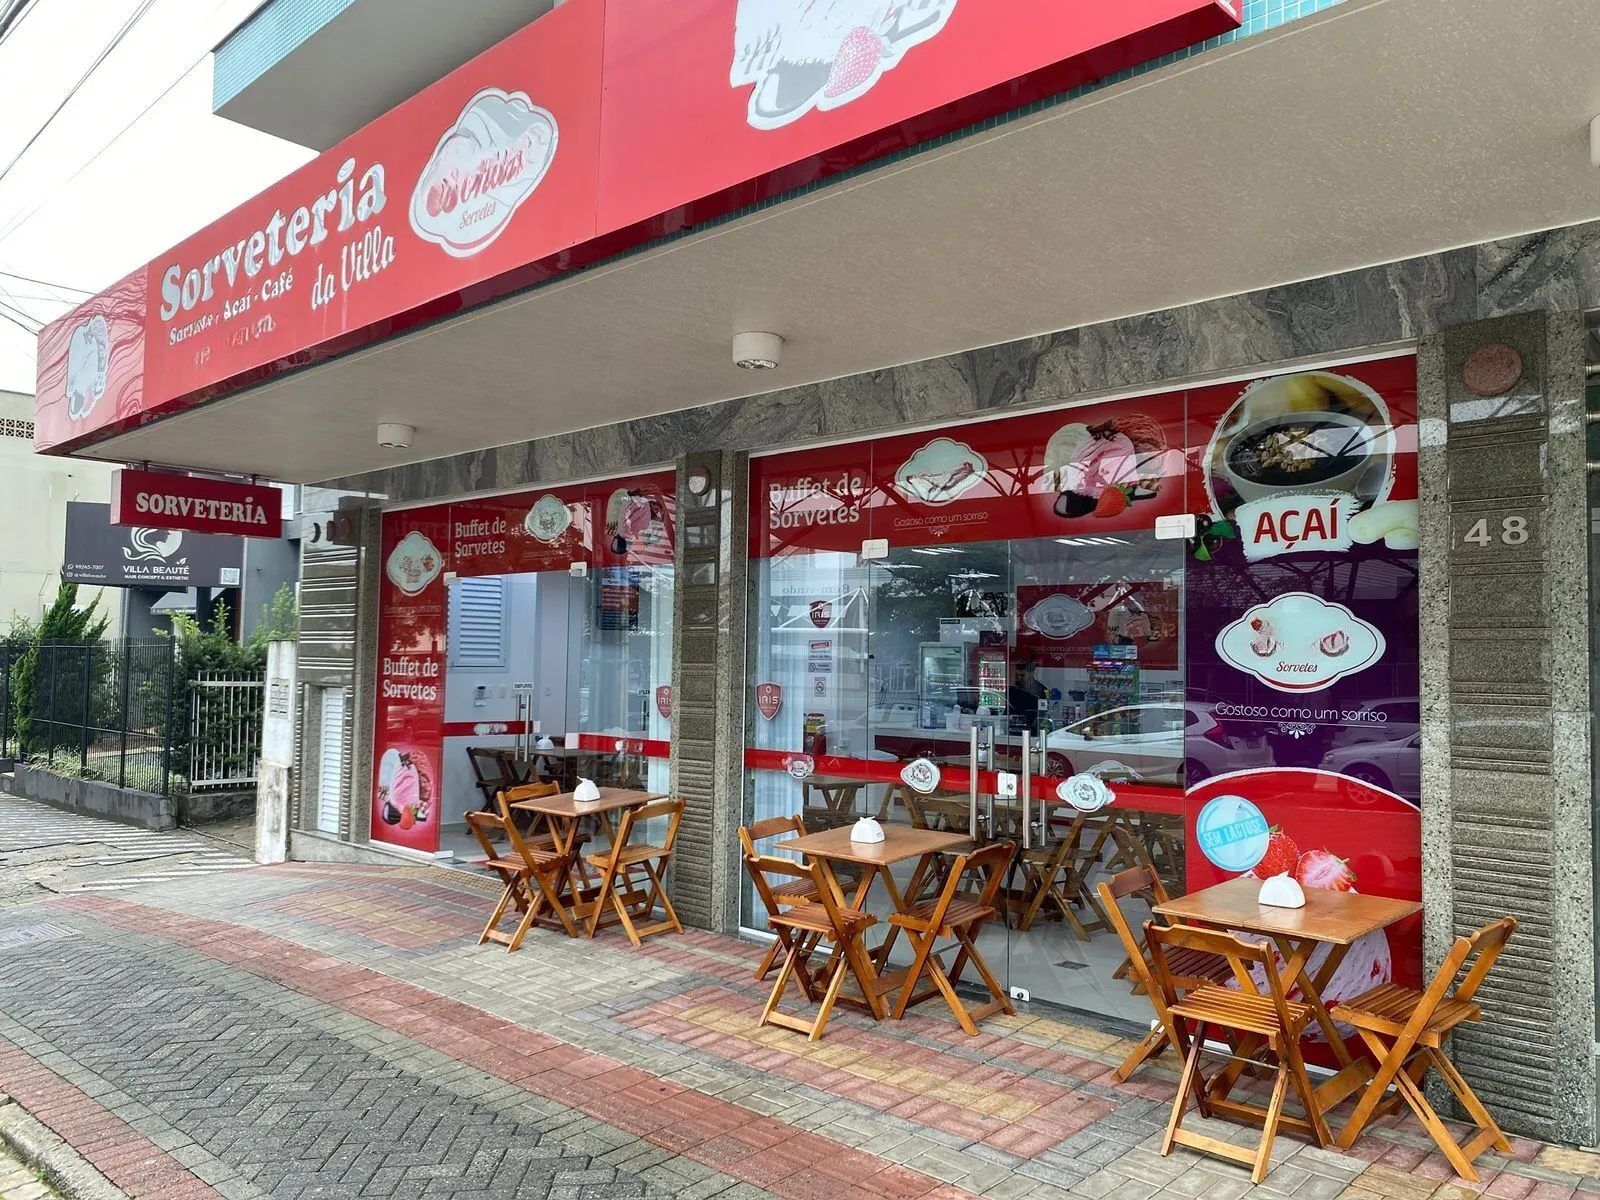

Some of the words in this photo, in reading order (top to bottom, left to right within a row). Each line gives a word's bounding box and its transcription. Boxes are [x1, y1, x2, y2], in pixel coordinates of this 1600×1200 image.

[459, 201, 497, 230] Sorvetes
[160, 157, 388, 322] Sorveteria
[311, 263, 336, 311] da
[341, 225, 396, 292] Villa
[262, 267, 294, 301] Café
[769, 475, 831, 504] Buffet
[836, 472, 862, 497] de
[454, 518, 489, 538] Buffet
[491, 516, 506, 535] de
[769, 505, 860, 530] Sorvetes
[893, 517, 924, 527] Gostoso
[924, 515, 948, 525] como
[948, 514, 962, 523] um
[963, 511, 989, 521] sorriso
[1253, 498, 1341, 550] AÇAÍ
[1463, 515, 1529, 547] 48
[454, 539, 505, 558] Sorvetes
[122, 565, 149, 574] VILLA
[152, 565, 190, 575] BEAUTÉ
[811, 611, 830, 619] IRIS
[383, 656, 420, 676] Buffet
[422, 657, 439, 678] de
[1275, 660, 1318, 673] Sorvetes
[382, 679, 437, 700] Sorvetes
[758, 695, 779, 705] IRIS
[1215, 701, 1268, 718] Gostoso
[1270, 706, 1312, 719] como
[1314, 708, 1339, 720] um
[1341, 708, 1388, 723] sorriso
[1202, 830, 1223, 848] SEM
[1224, 817, 1264, 843] LACTOSE
